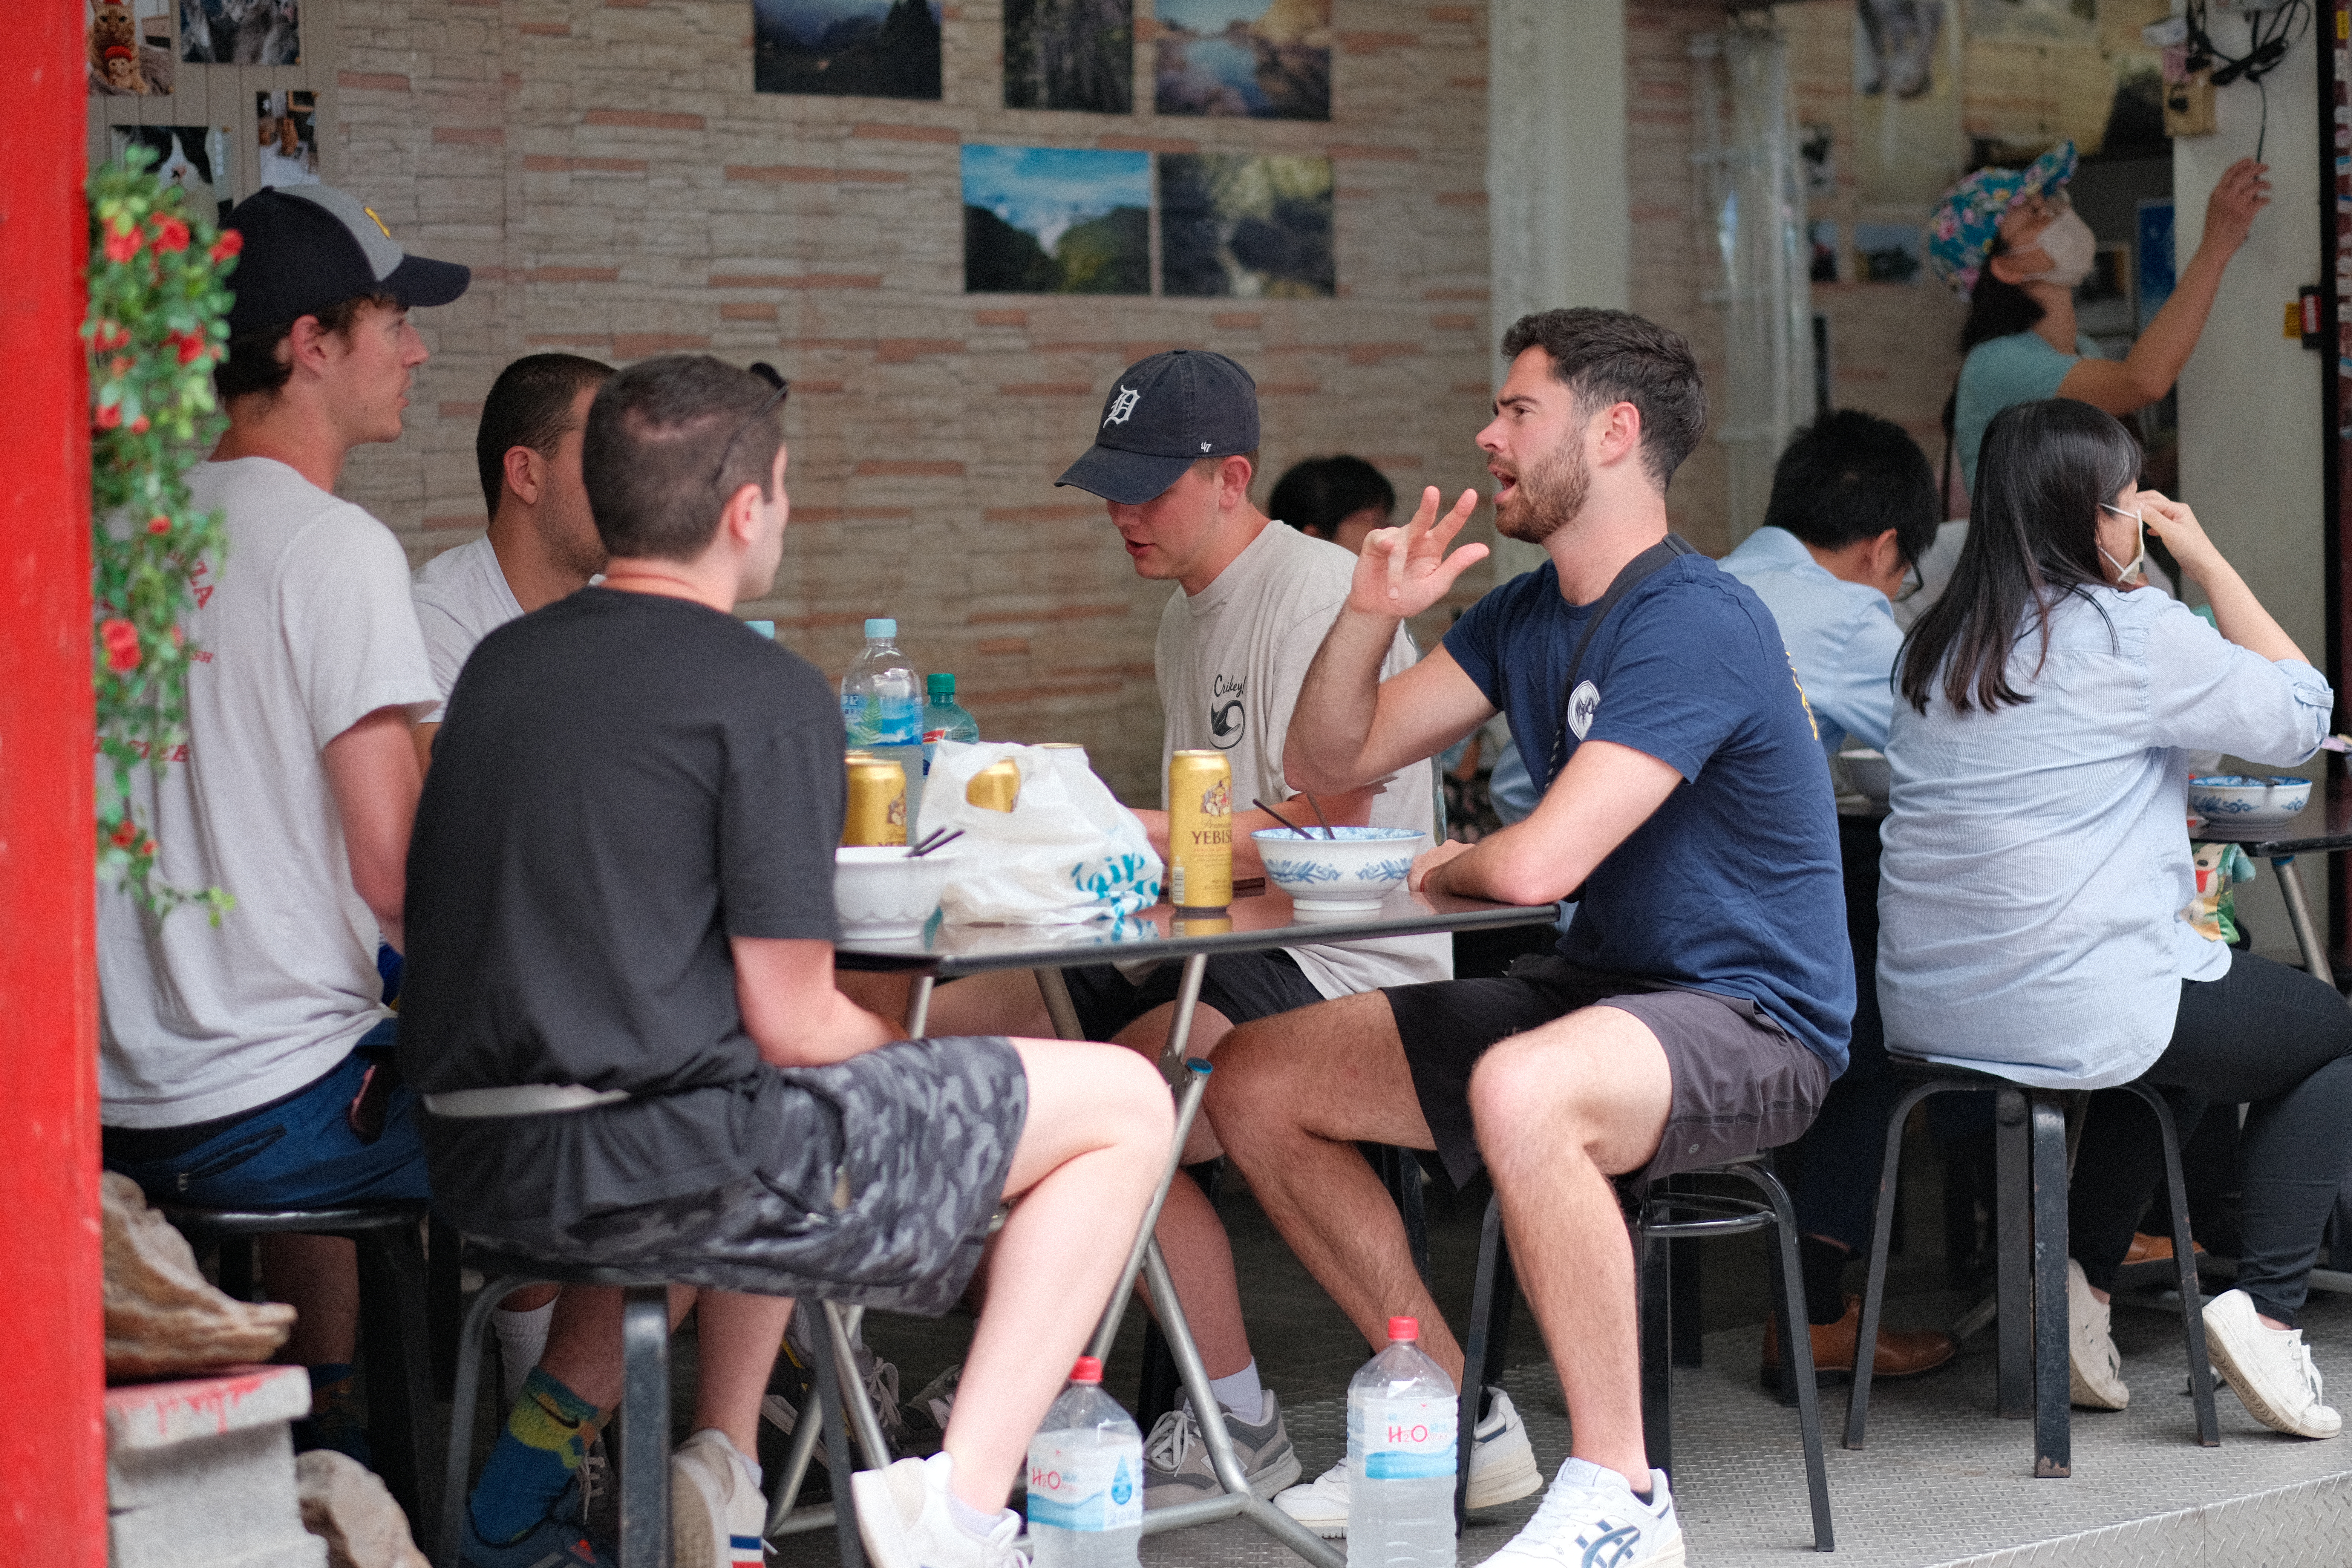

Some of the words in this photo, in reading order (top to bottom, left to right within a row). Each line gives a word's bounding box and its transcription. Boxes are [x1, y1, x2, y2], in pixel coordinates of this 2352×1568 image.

[1102, 384, 1141, 428] D
[1214, 674, 1246, 697] Crikey!
[1191, 829, 1232, 845] YEBIS
